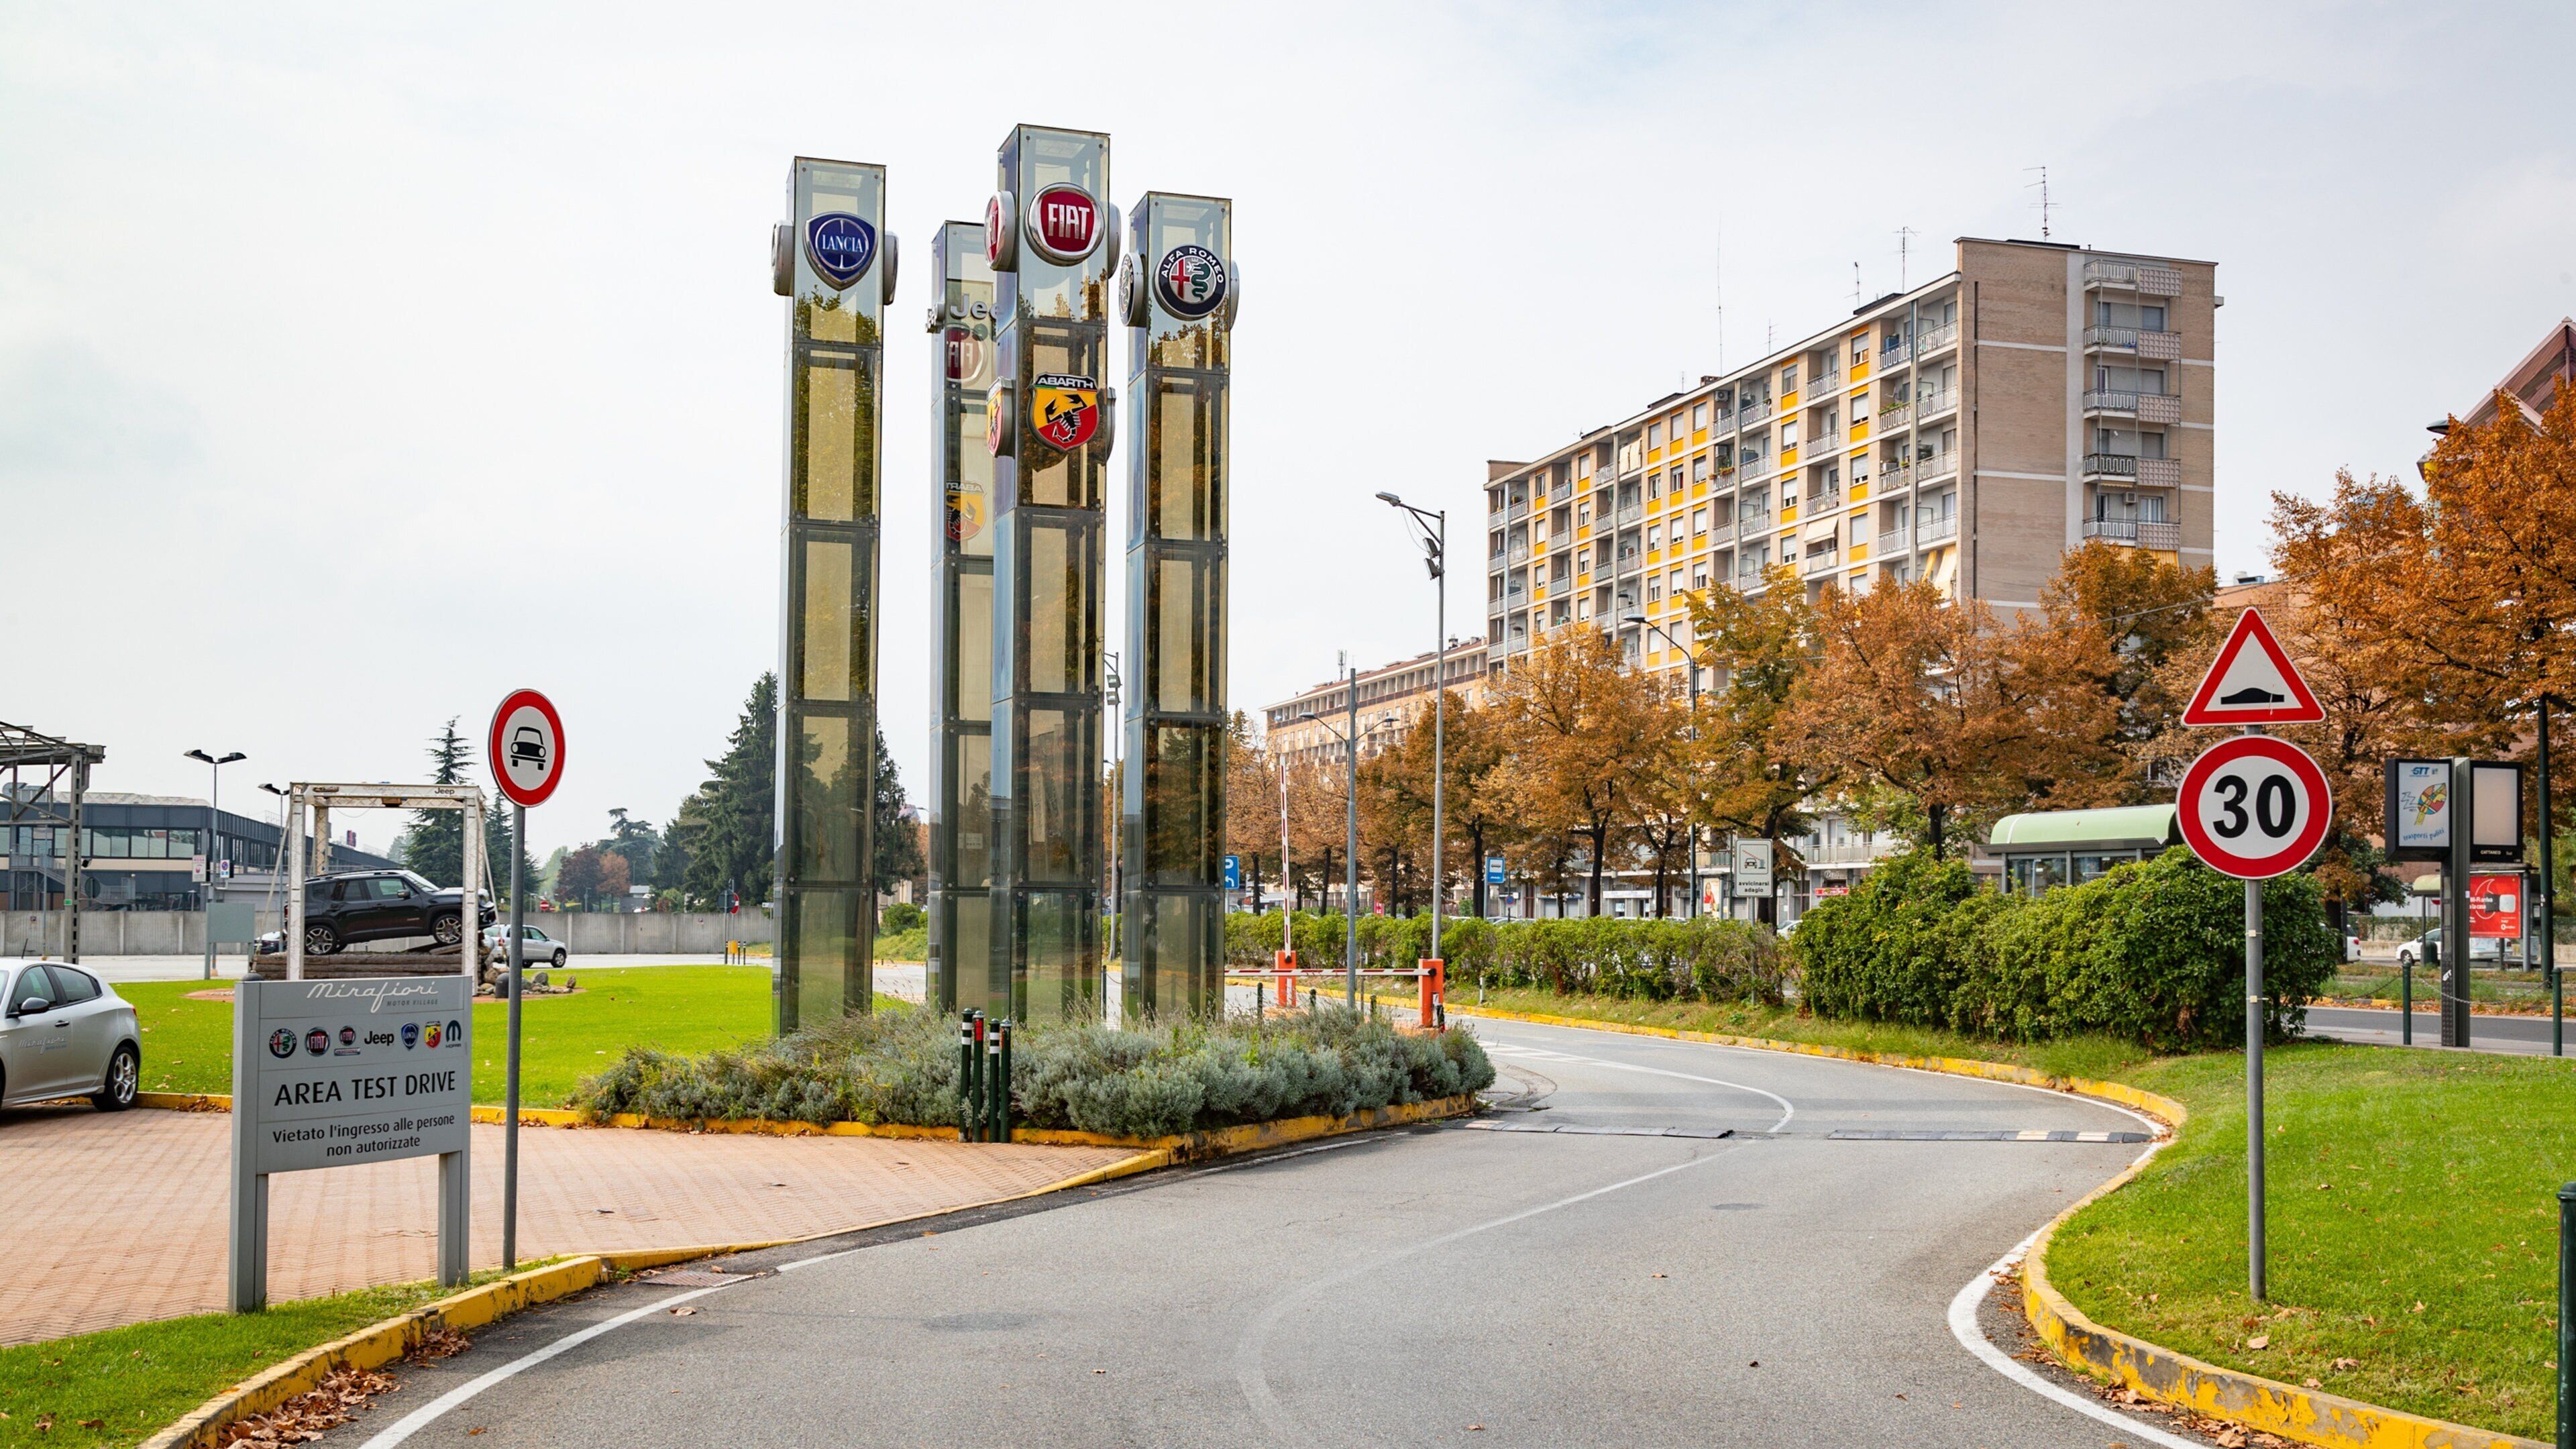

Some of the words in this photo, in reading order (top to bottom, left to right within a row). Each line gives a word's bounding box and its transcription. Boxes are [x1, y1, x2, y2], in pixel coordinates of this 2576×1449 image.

[1048, 203, 1090, 240] FIAT
[822, 234, 863, 253] LANCIA
[1161, 251, 1184, 278] ALFA
[1189, 247, 1224, 284] ROMEO
[1037, 376, 1093, 389] ABARTH
[2213, 774, 2296, 839] 30
[2430, 826, 2445, 841] puliti
[307, 981, 438, 1013] Mirafiori
[311, 1036, 325, 1049] FIAT
[343, 1032, 352, 1040] FIAT
[364, 1030, 394, 1046] Jeep
[274, 1081, 342, 1106] AREA
[352, 1076, 397, 1100] TEST
[405, 1071, 455, 1095] DRIVE
[272, 1128, 325, 1143] Vietato
[329, 1122, 390, 1139] l'ingresso
[393, 1118, 413, 1131] alle
[417, 1115, 455, 1132] persone
[327, 1144, 352, 1157] non
[356, 1136, 421, 1154] autorizzate
